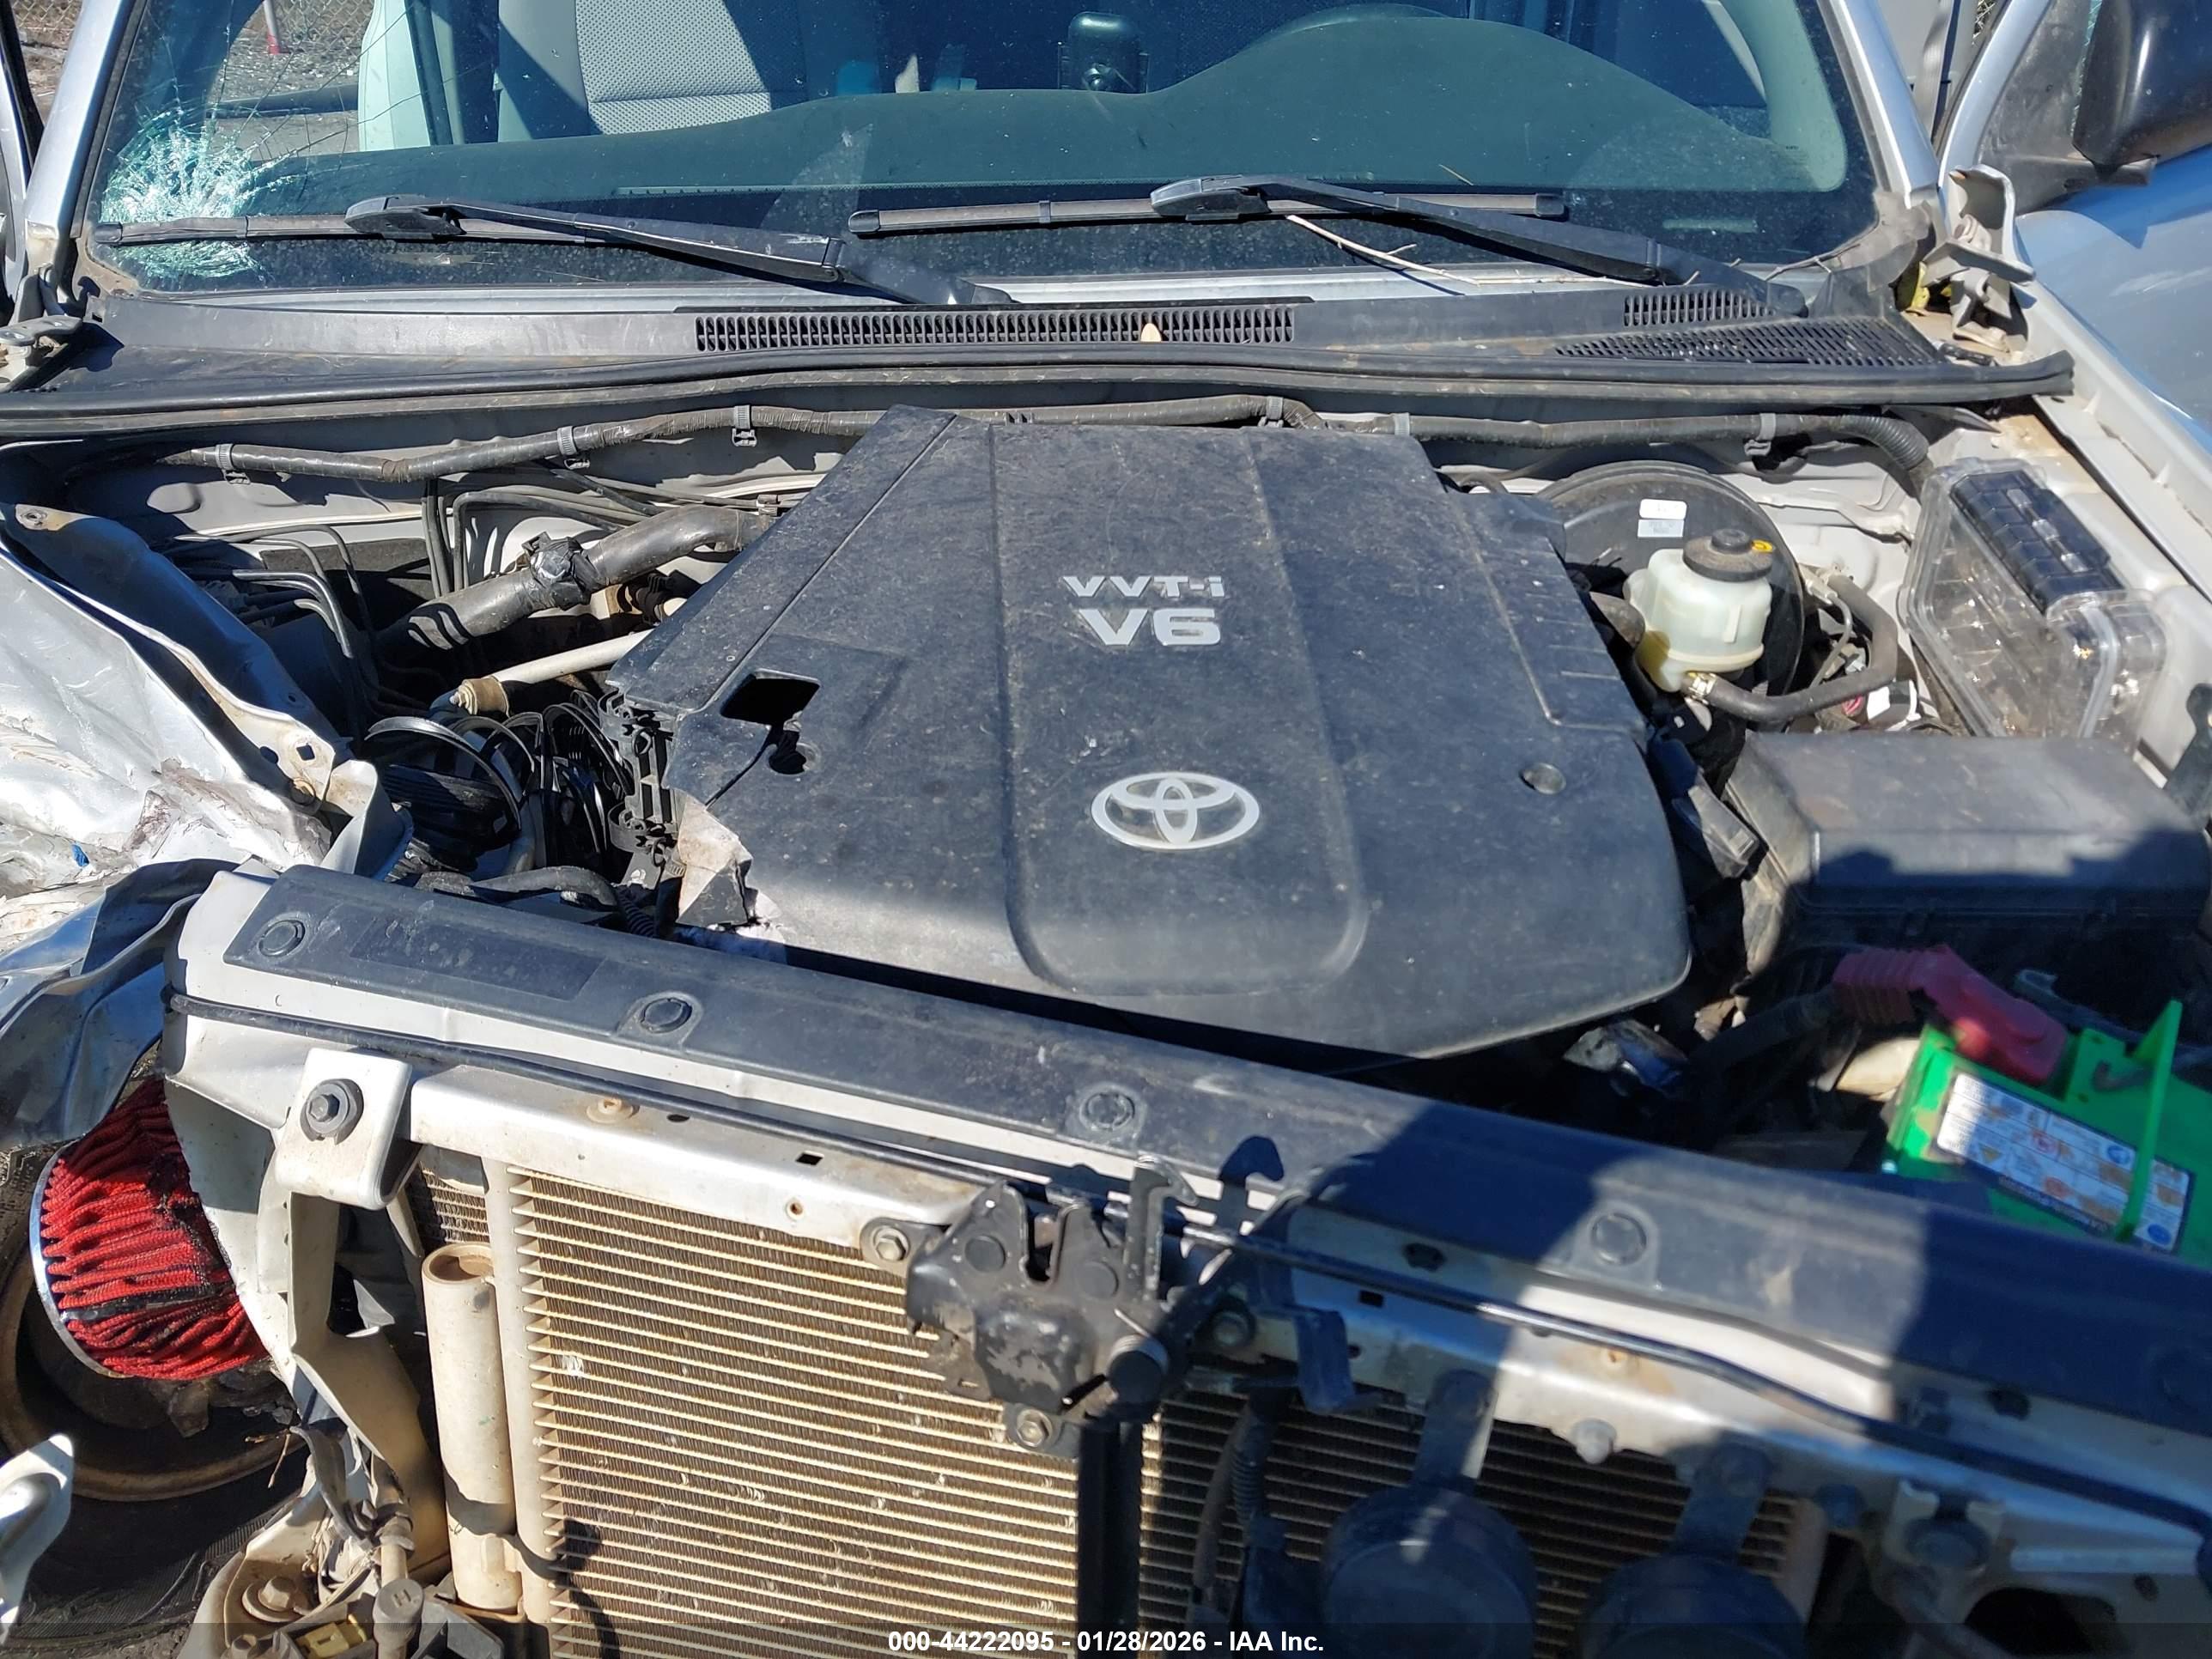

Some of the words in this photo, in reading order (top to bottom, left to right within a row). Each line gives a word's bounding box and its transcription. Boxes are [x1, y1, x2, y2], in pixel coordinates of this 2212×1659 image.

[1061, 574, 1225, 599] VVT-i
[1078, 608, 1221, 647] V6
[392, 1589, 412, 1608] H
